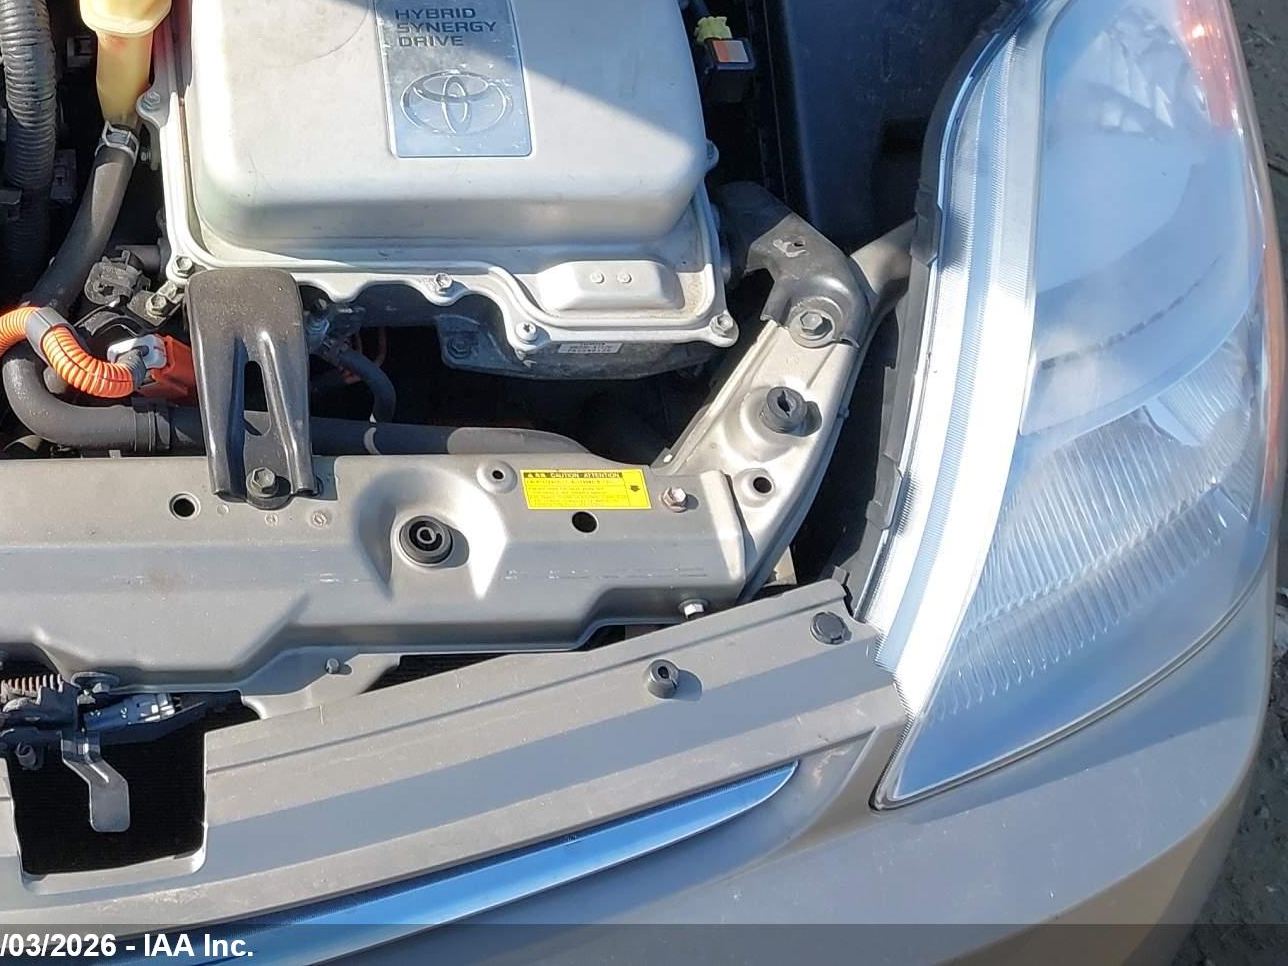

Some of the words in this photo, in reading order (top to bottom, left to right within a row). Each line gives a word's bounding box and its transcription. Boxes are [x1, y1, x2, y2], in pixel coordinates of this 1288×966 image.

[395, 7, 477, 20] HYBRID
[397, 21, 497, 34] SYNERGY
[399, 35, 465, 48] DRIVE
